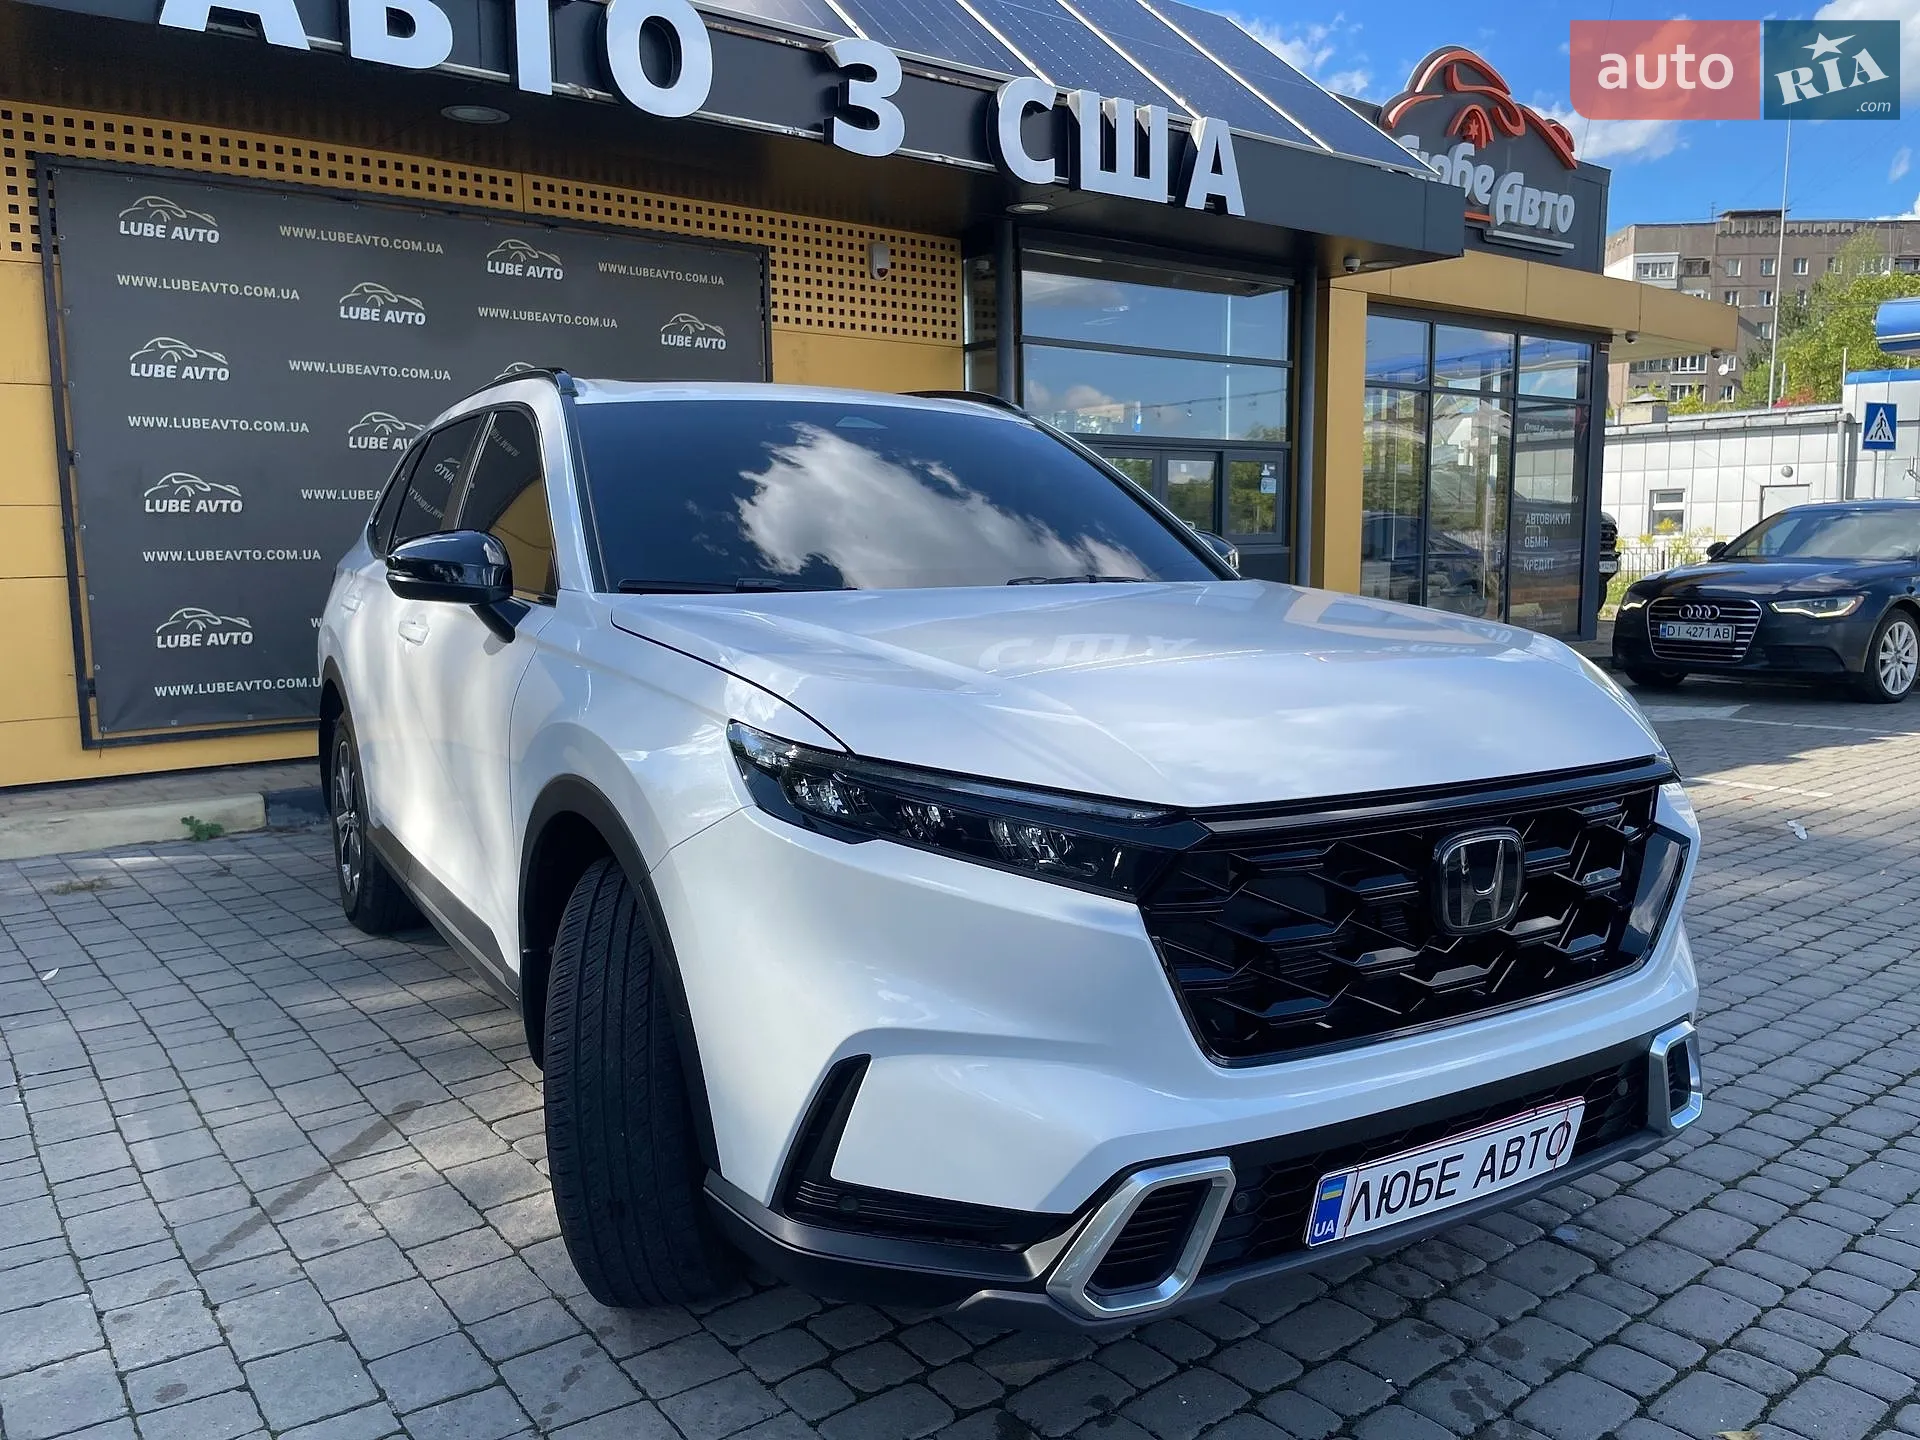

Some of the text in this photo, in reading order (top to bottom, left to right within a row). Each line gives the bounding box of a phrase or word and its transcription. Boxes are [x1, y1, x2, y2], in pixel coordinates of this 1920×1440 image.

[824, 37, 905, 157] З
[998, 76, 1246, 217] США
[120, 219, 219, 243] LUBE AVTO
[280, 226, 443, 254] WWW.LUBEAVTO.COM.UA
[487, 260, 563, 280] LUBE AVTO
[598, 262, 724, 285] WWW.LUBEAVTO.COM.UA
[117, 275, 299, 300] WWW.LUBEAVTO.COM.UA
[340, 305, 425, 325] LUBE AVTO
[478, 307, 617, 328] WWW.LUBEAVTO.COM.UA
[661, 333, 726, 349] LUBE AVTO
[131, 363, 229, 380] LUBE AVTO
[289, 360, 451, 380] WWW.LUBEAVTO.COM.UA
[128, 416, 309, 432] WWW.LUBEAVTO.COM.UA
[349, 436, 388, 449] LUBE
[145, 500, 242, 512] LUBE AVTO
[143, 550, 321, 561] WWW.LUBEAVTO.COM.UA
[156, 632, 252, 648] LUBE AVTO
[1344, 1120, 1572, 1227] ЛЮБЕ АВТО
[1314, 1219, 1335, 1238] UA
